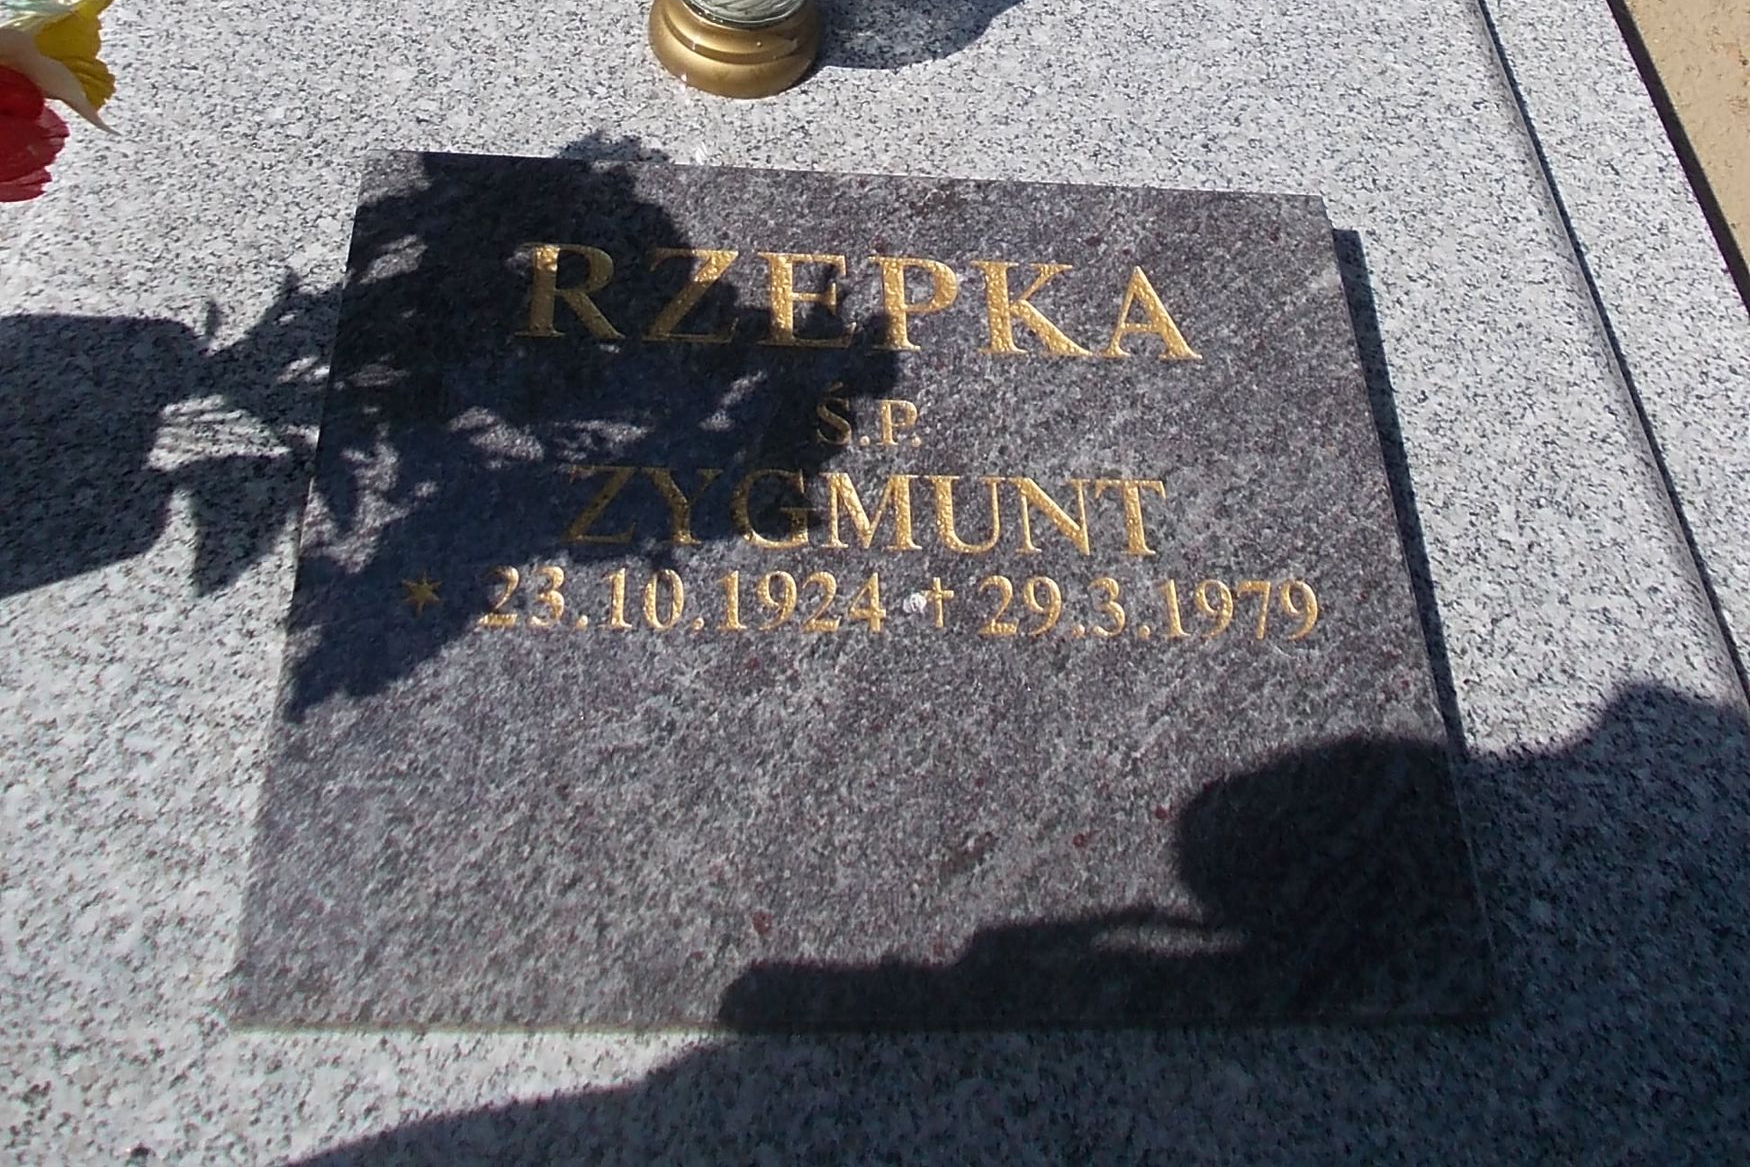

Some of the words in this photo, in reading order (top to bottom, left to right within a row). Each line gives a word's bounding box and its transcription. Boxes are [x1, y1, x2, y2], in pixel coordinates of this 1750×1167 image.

[514, 242, 1203, 361] RZEPKA
[562, 465, 1166, 556] ZYGMUNT
[477, 565, 886, 633] 23.10.1924
[979, 575, 1318, 640] 29.3.1979
